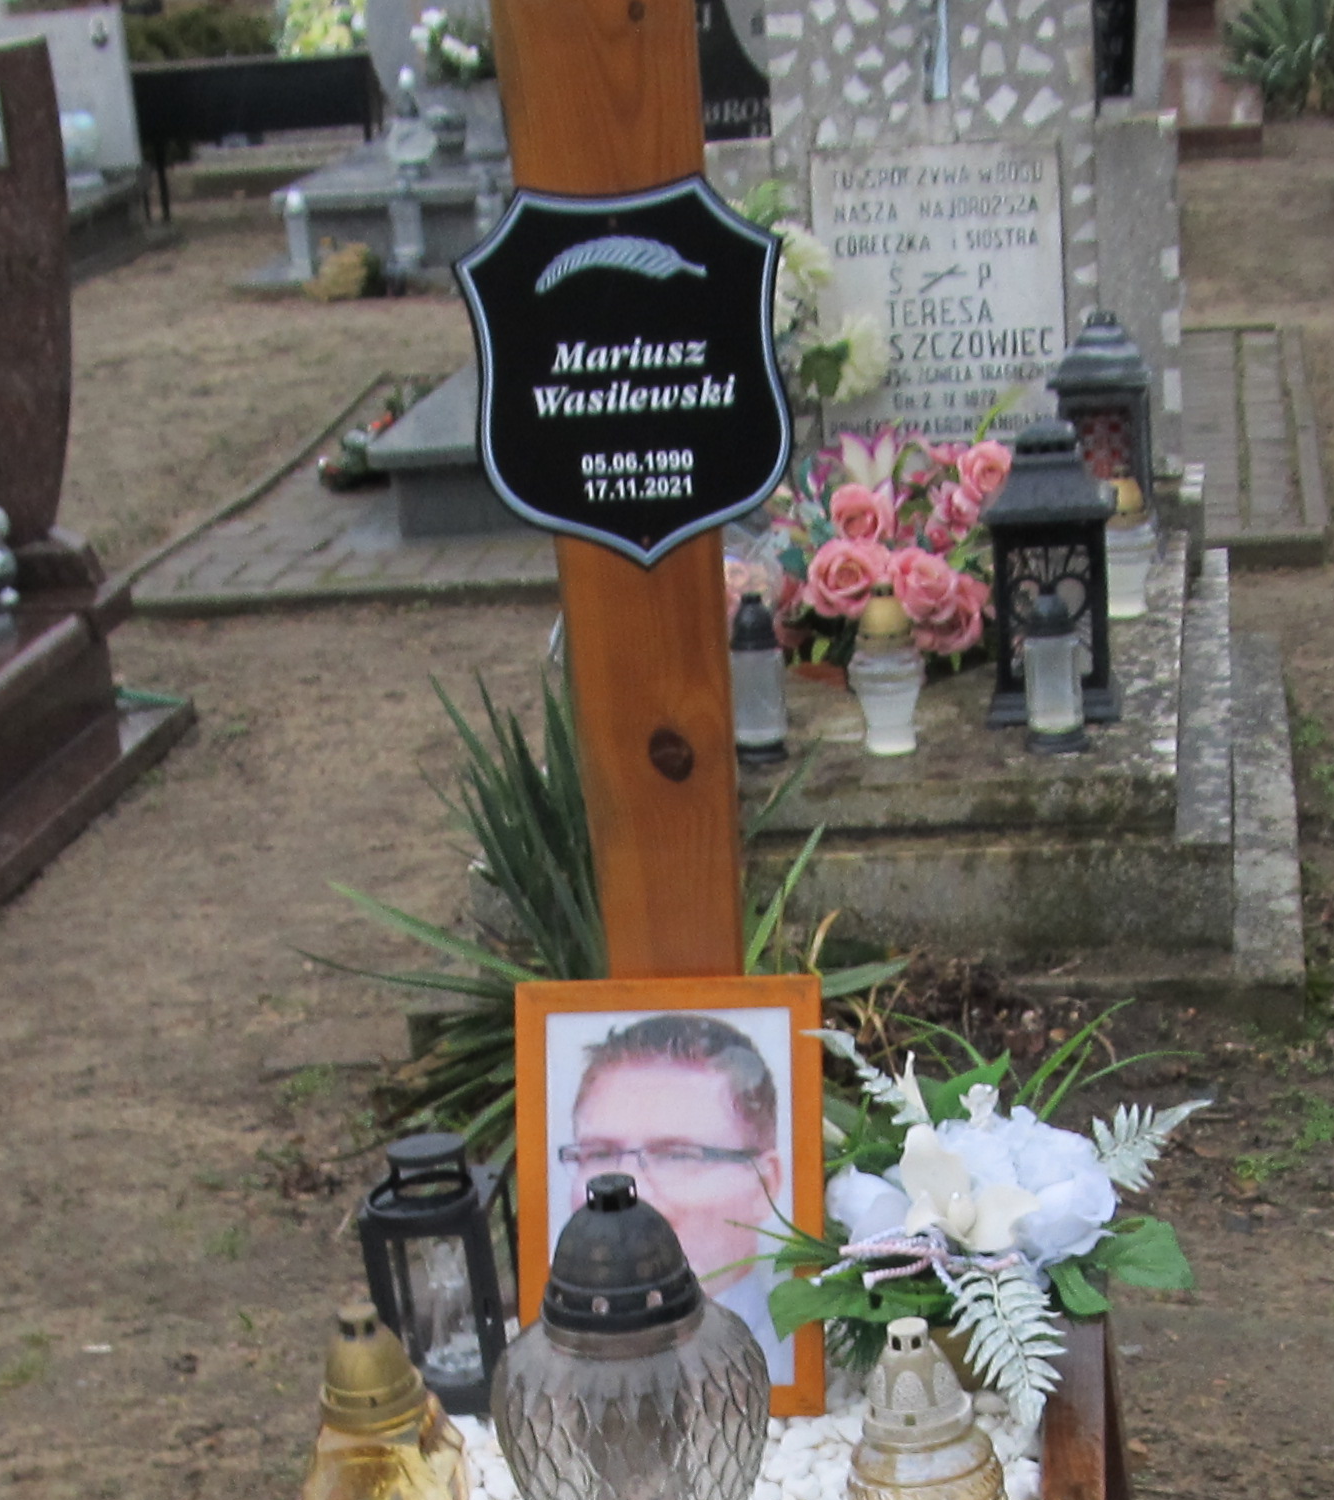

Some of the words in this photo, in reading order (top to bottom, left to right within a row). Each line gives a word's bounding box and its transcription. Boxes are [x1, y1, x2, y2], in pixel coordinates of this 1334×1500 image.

[833, 201, 898, 224] NASZA
[965, 227, 1039, 250] SIOSTRA
[886, 297, 994, 328] TERESA
[550, 335, 708, 374] Mariusz
[889, 327, 1055, 363] SZCZOWIEC
[533, 372, 736, 419] Wasilewski
[581, 449, 694, 475] 05.06.1990
[583, 475, 694, 501] 17.11.2021
